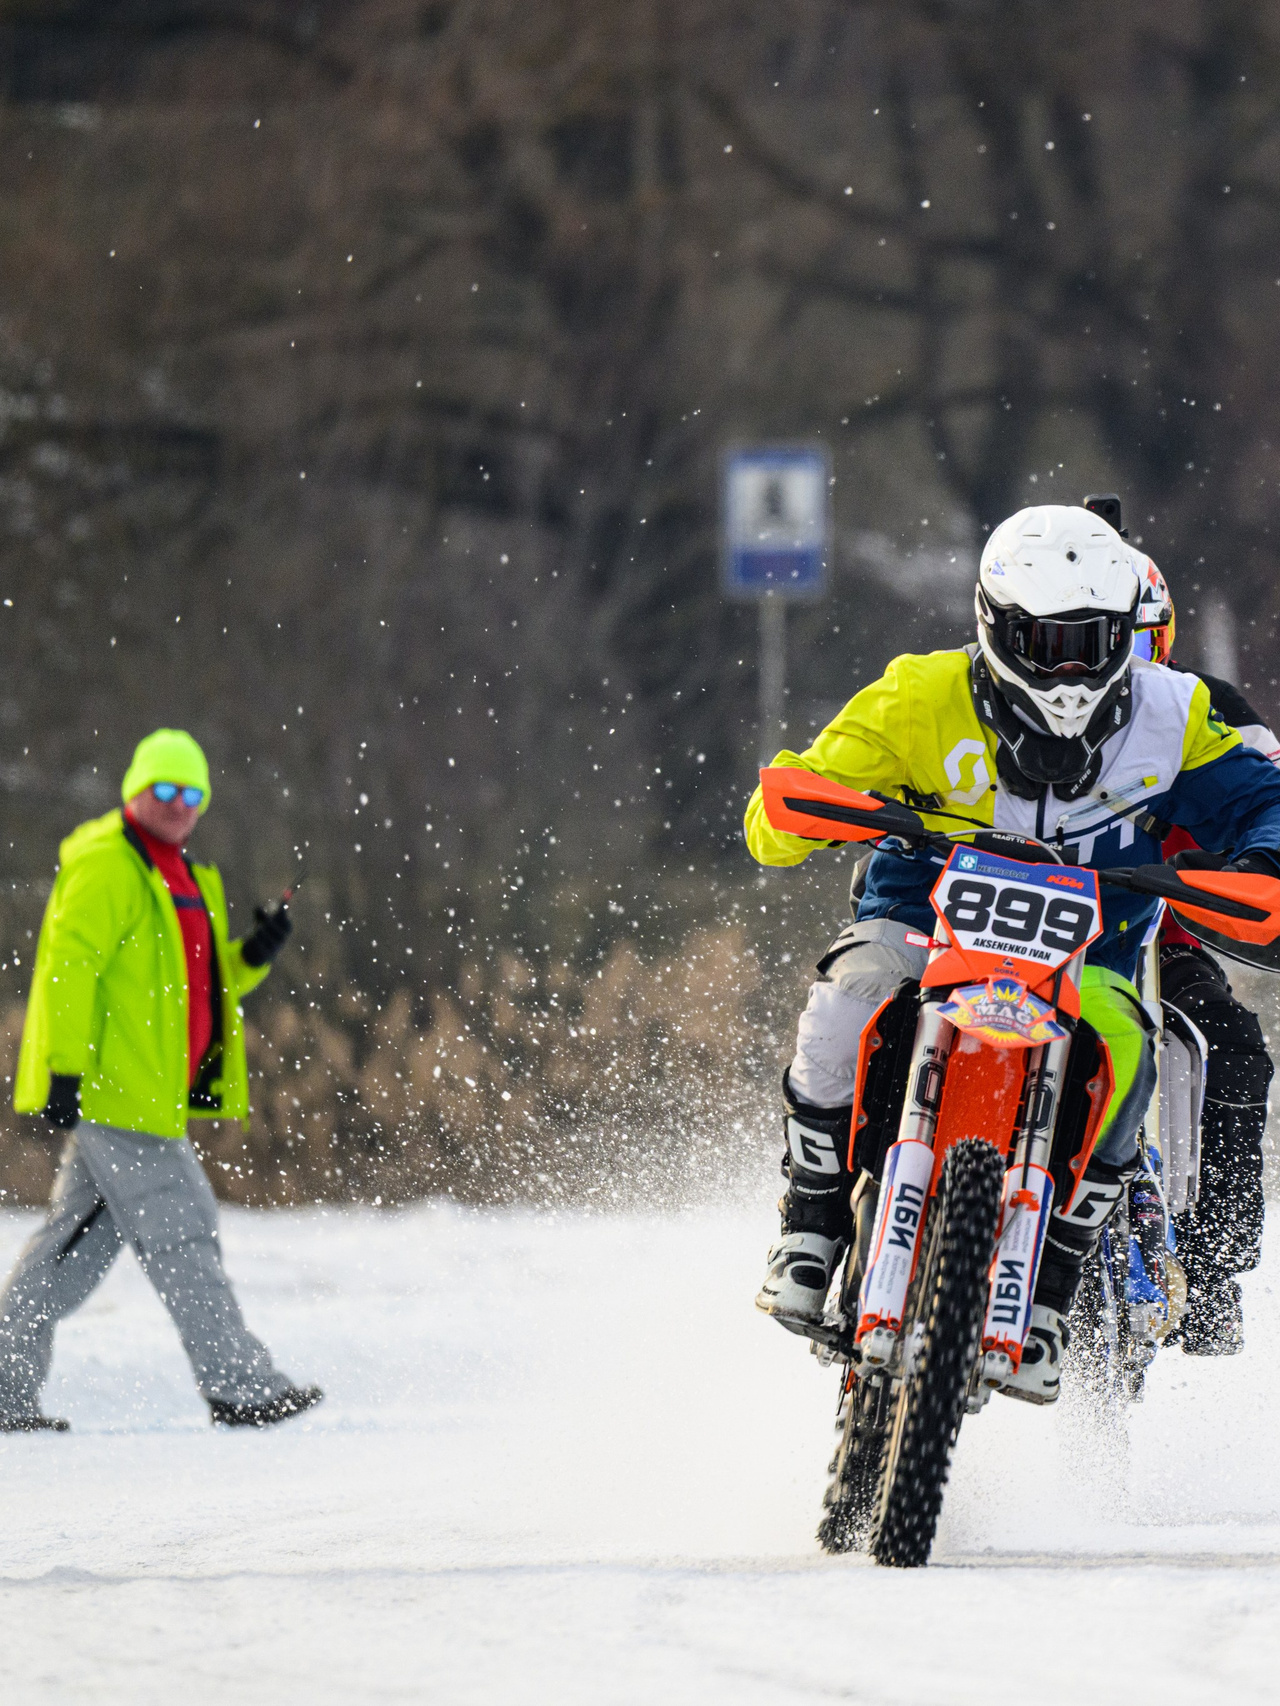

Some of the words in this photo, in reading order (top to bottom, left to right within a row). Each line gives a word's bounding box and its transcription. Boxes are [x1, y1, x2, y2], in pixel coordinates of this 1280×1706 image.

[991, 833, 1015, 843] READY
[977, 865, 1029, 880] NEURODAT
[1045, 874, 1084, 890] KTM
[943, 878, 1095, 954] 899
[972, 938, 1029, 956] AKSENENKO
[1028, 948, 1052, 961] IVAN
[974, 1001, 1034, 1026] MAG
[888, 1182, 924, 1251] ЦБИ
[992, 1259, 1025, 1326] ЦБИ
